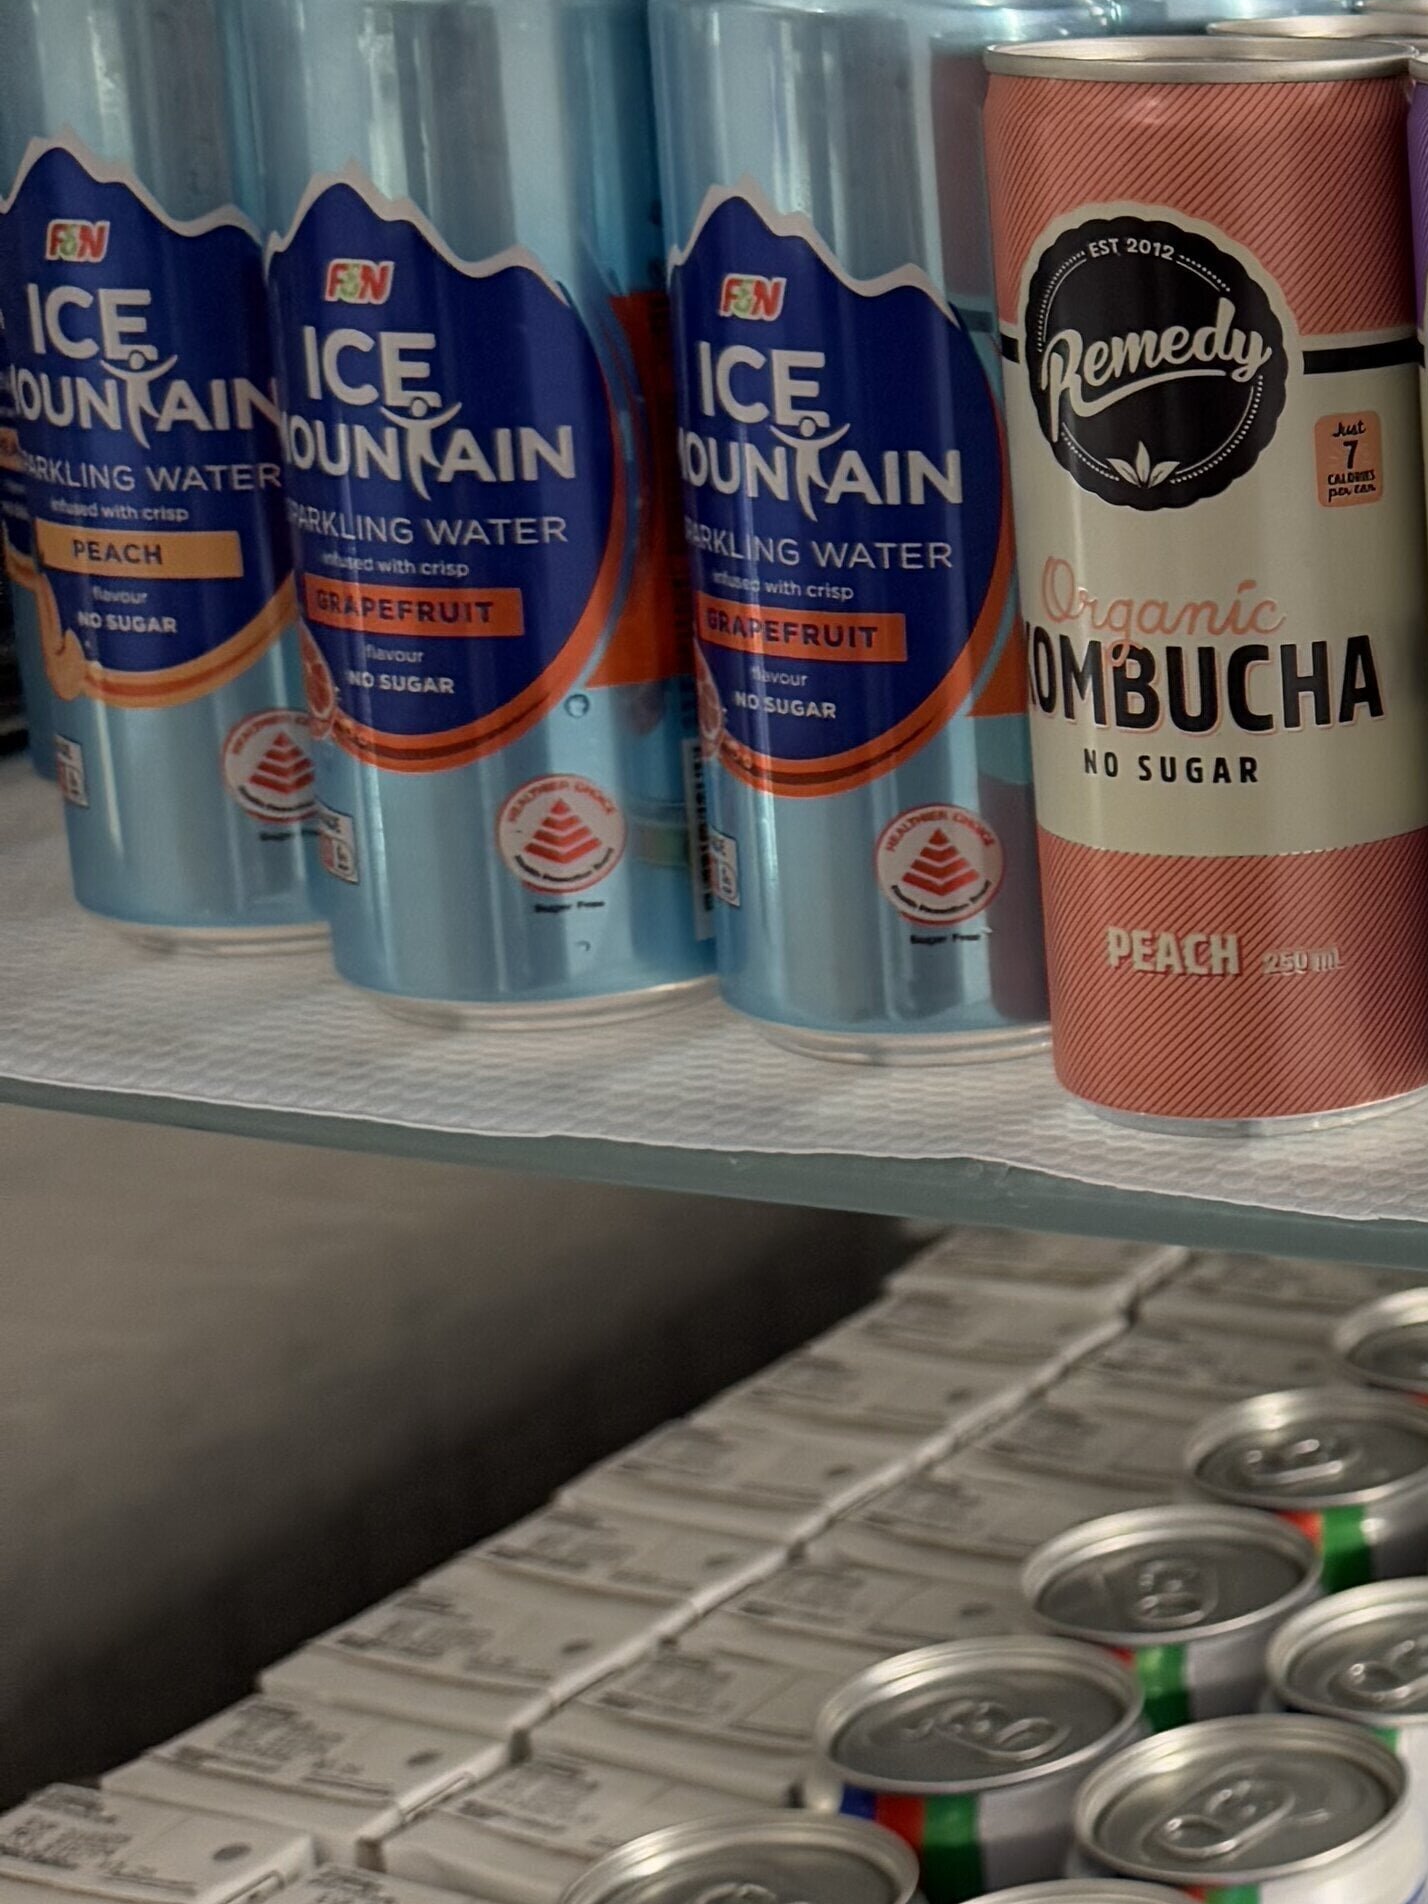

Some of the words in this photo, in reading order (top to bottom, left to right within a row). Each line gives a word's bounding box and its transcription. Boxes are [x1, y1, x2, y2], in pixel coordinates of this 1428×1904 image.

[1087, 237, 1120, 261] EST
[1126, 236, 1177, 263] 2012
[26, 283, 159, 364] ICE
[303, 325, 443, 409] ICE
[1040, 296, 1273, 444] Remedy
[694, 340, 831, 428] ICE
[1330, 420, 1367, 438] Just
[1343, 439, 1359, 470] 7
[148, 460, 284, 492] WATER
[427, 515, 569, 546] WATER
[72, 537, 164, 567] PEACH
[811, 540, 955, 570] WATER
[419, 559, 470, 580] crisp
[314, 587, 494, 625] GRAPEFRUIT
[806, 581, 855, 603] crisp
[78, 609, 103, 631] NO
[104, 611, 179, 636] SUGAR
[1040, 556, 1287, 668] Organic
[706, 607, 879, 651] GRAPEFRUIT
[347, 668, 377, 692] NO
[379, 671, 456, 696] SUGAR
[733, 691, 761, 713] NO
[761, 696, 837, 721] SUGAR
[1082, 748, 1120, 779] NO
[1137, 754, 1260, 785] SUGAR
[1105, 926, 1242, 977] PEACH
